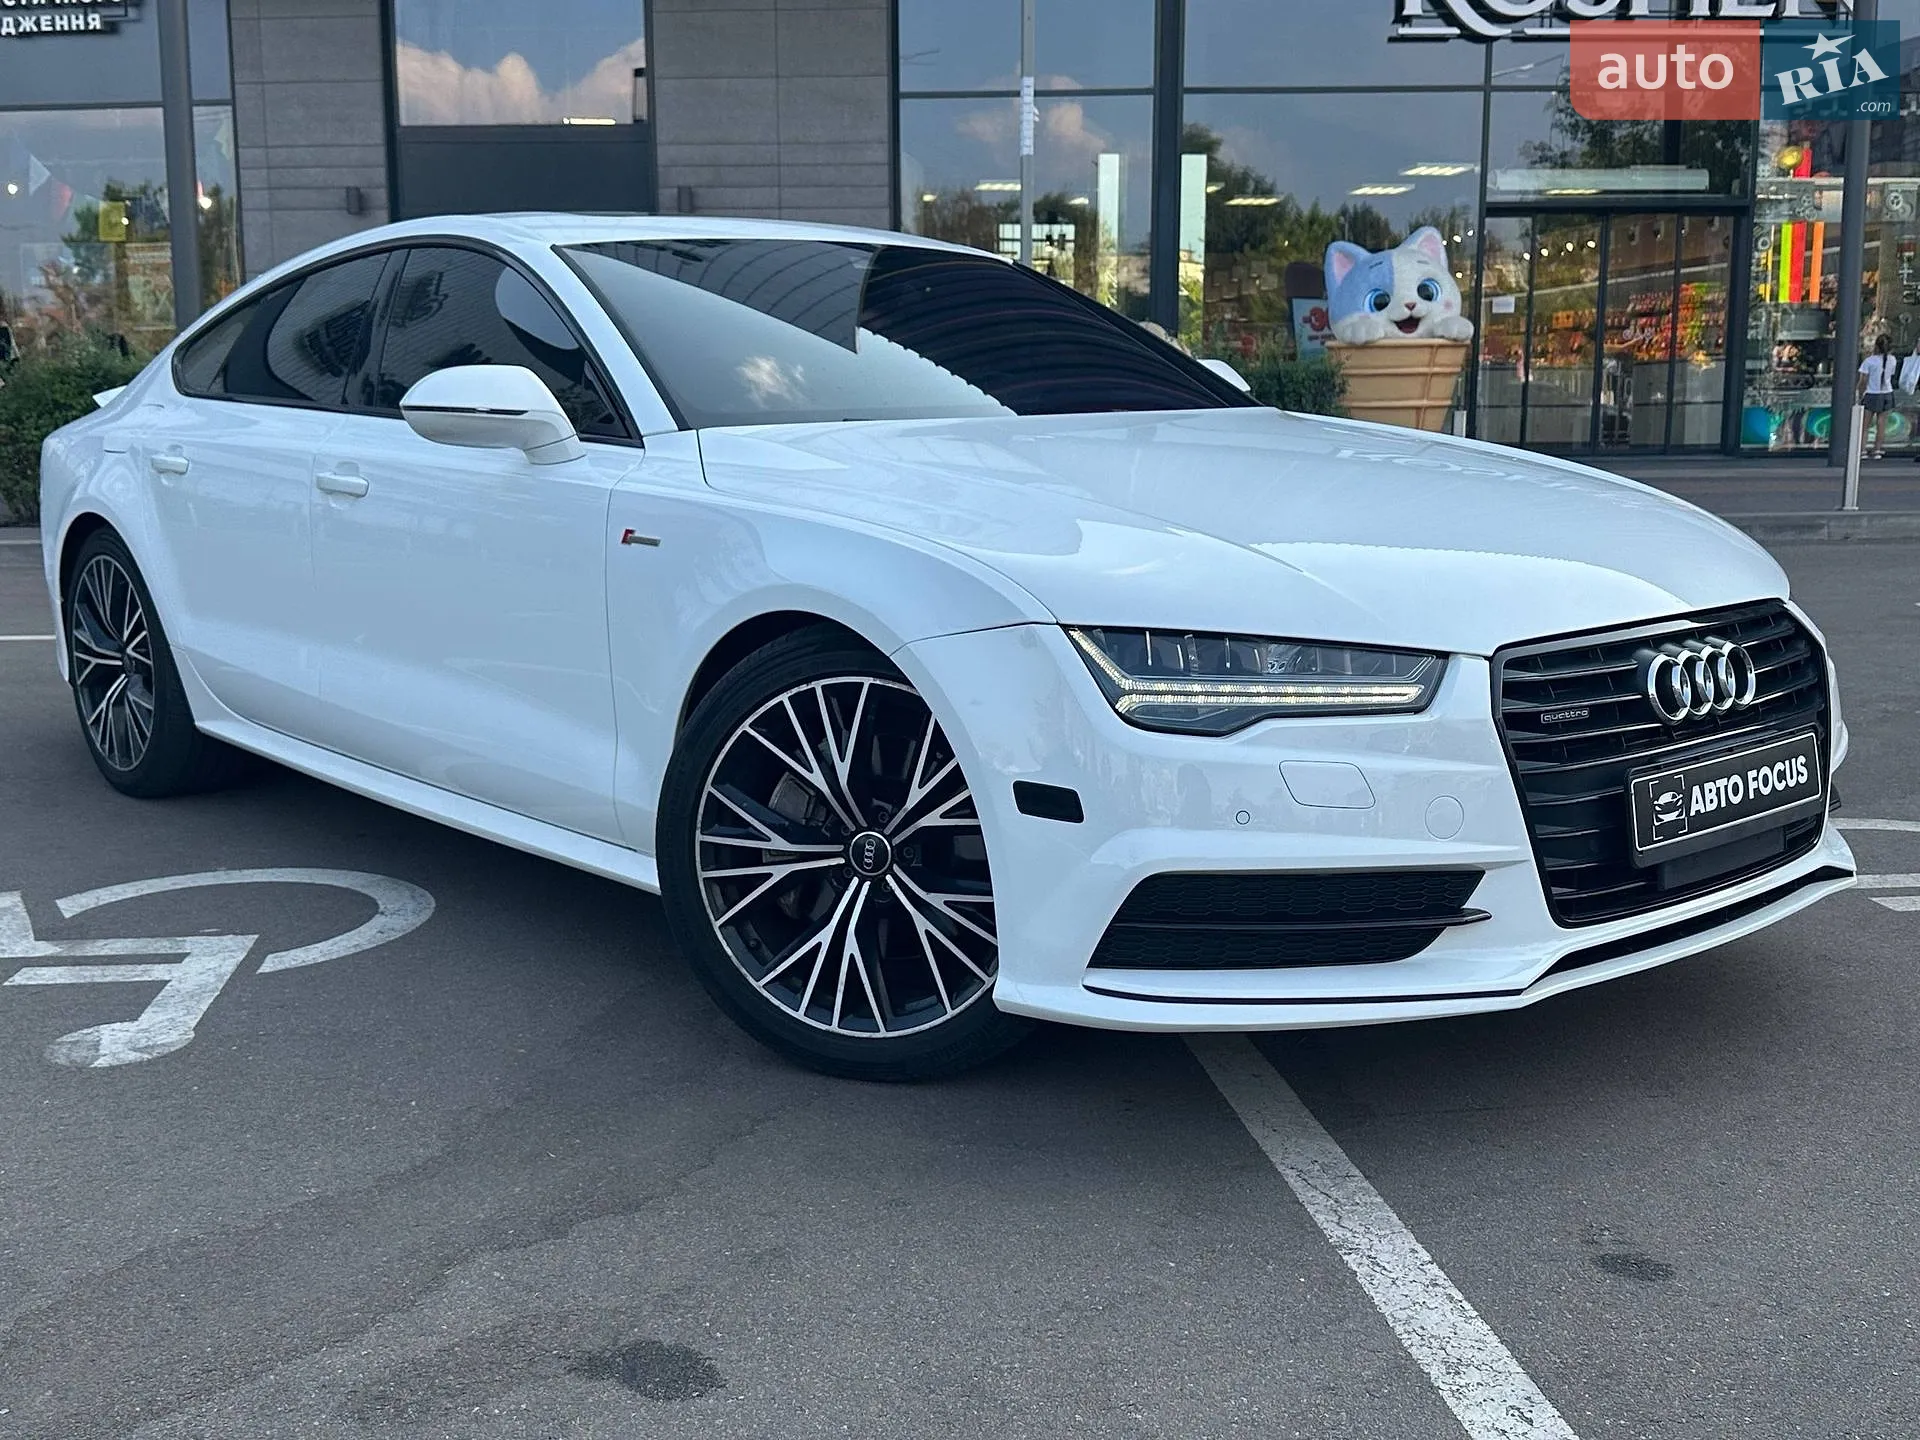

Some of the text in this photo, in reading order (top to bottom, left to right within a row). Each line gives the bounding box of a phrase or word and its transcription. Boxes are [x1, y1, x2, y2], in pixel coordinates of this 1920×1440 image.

[0, 13, 102, 36] ДЖЕННЯ
[1543, 708, 1589, 723] quattro
[1689, 755, 1808, 817] АВТО FOCUS
